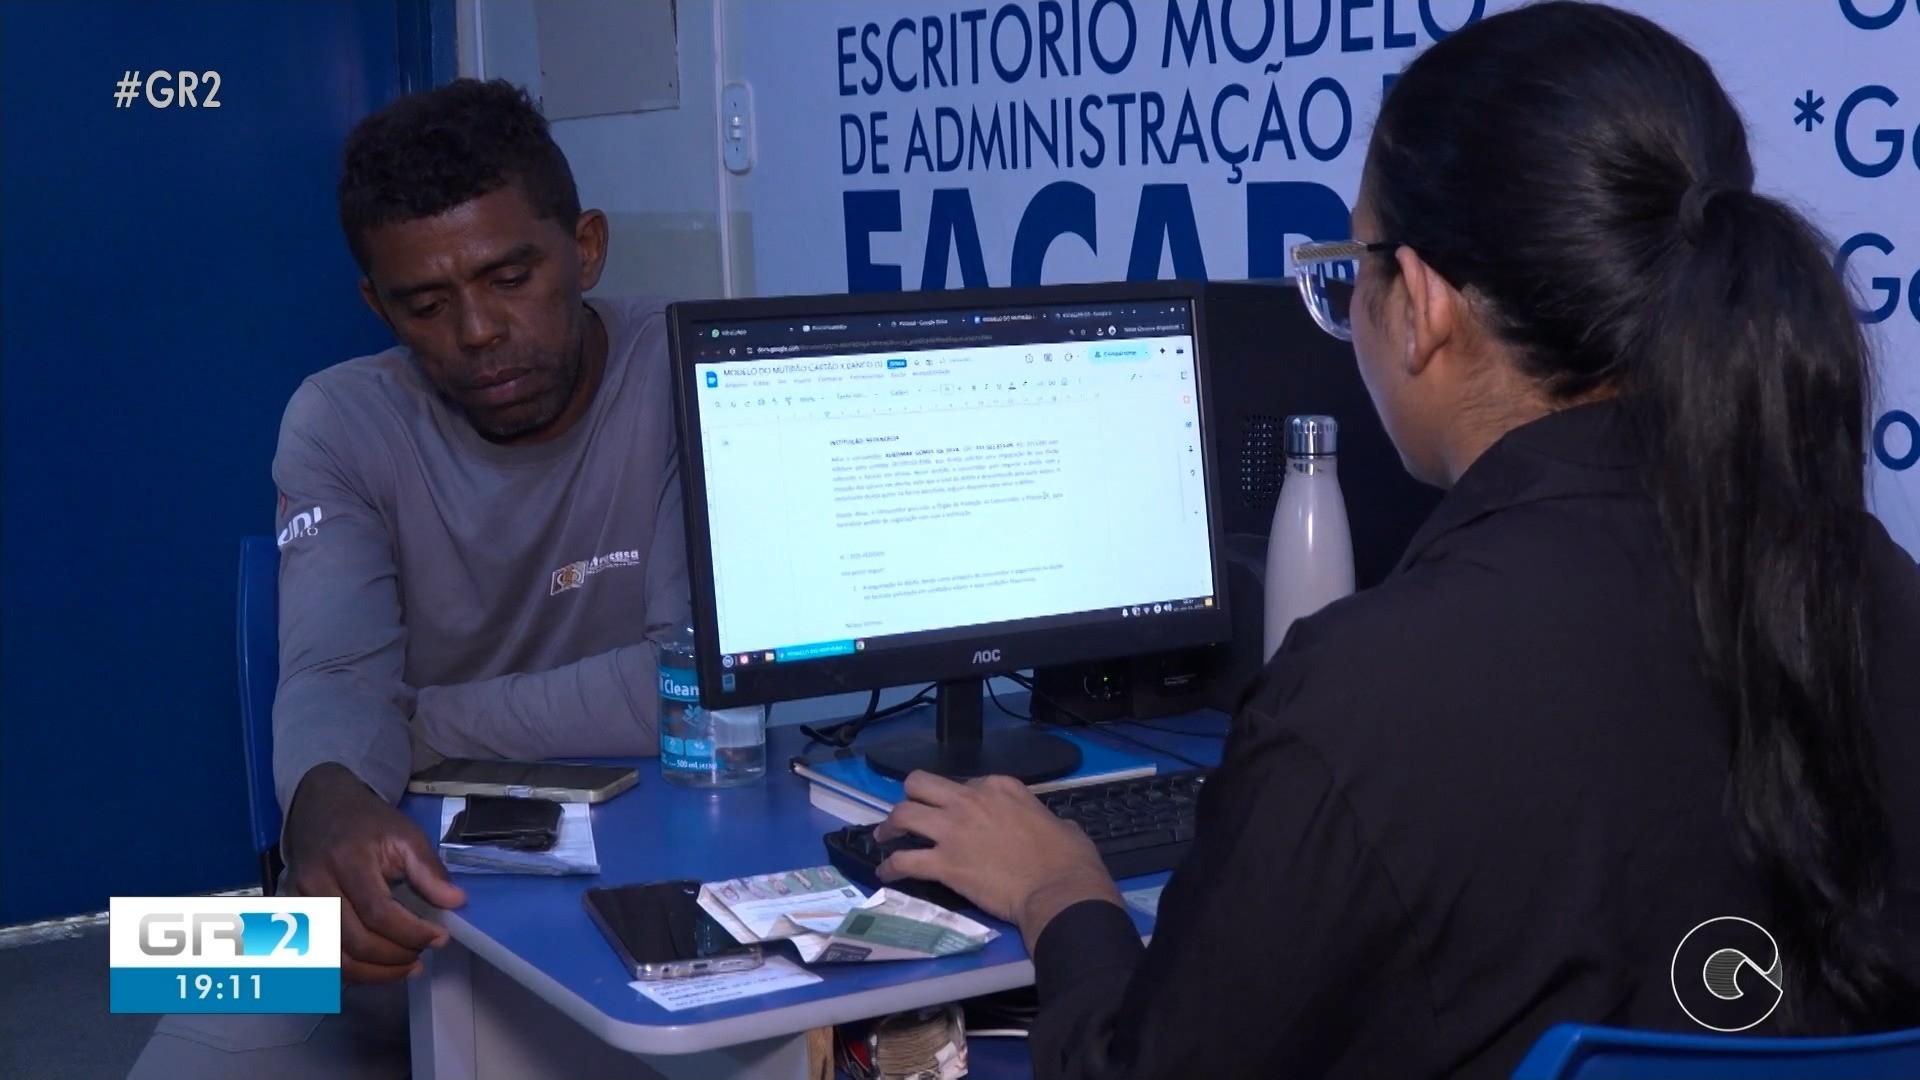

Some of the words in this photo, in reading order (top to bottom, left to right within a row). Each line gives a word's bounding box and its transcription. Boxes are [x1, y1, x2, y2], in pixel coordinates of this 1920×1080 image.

[1161, 0, 1486, 69] MODELO
[841, 110, 890, 175] DE
[904, 63, 1353, 184] ADMINISTRAÇÃO
[971, 649, 1002, 664] AOC
[664, 679, 700, 697] Clean
